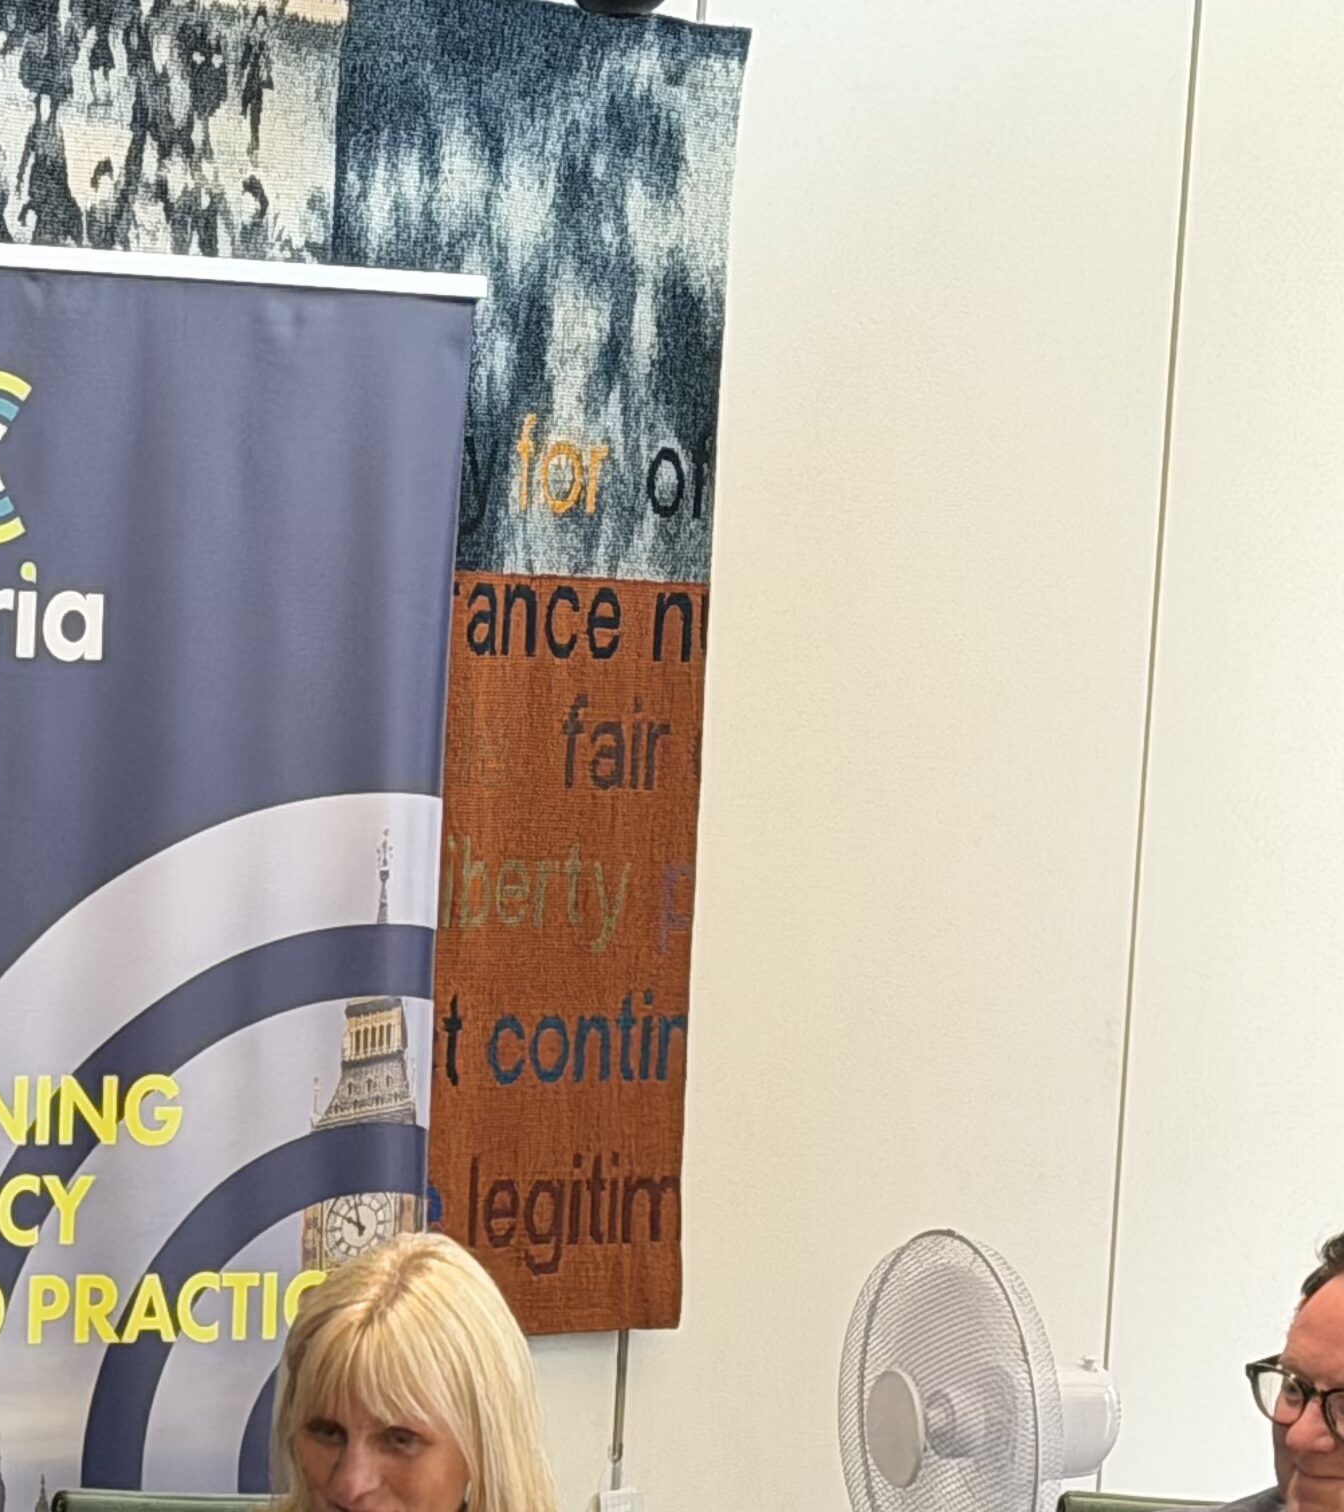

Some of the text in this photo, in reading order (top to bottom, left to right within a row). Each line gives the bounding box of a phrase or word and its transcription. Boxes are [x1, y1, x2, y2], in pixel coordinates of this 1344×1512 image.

[516, 412, 609, 515] for
[454, 580, 624, 661] ance
[562, 690, 672, 791] fair
